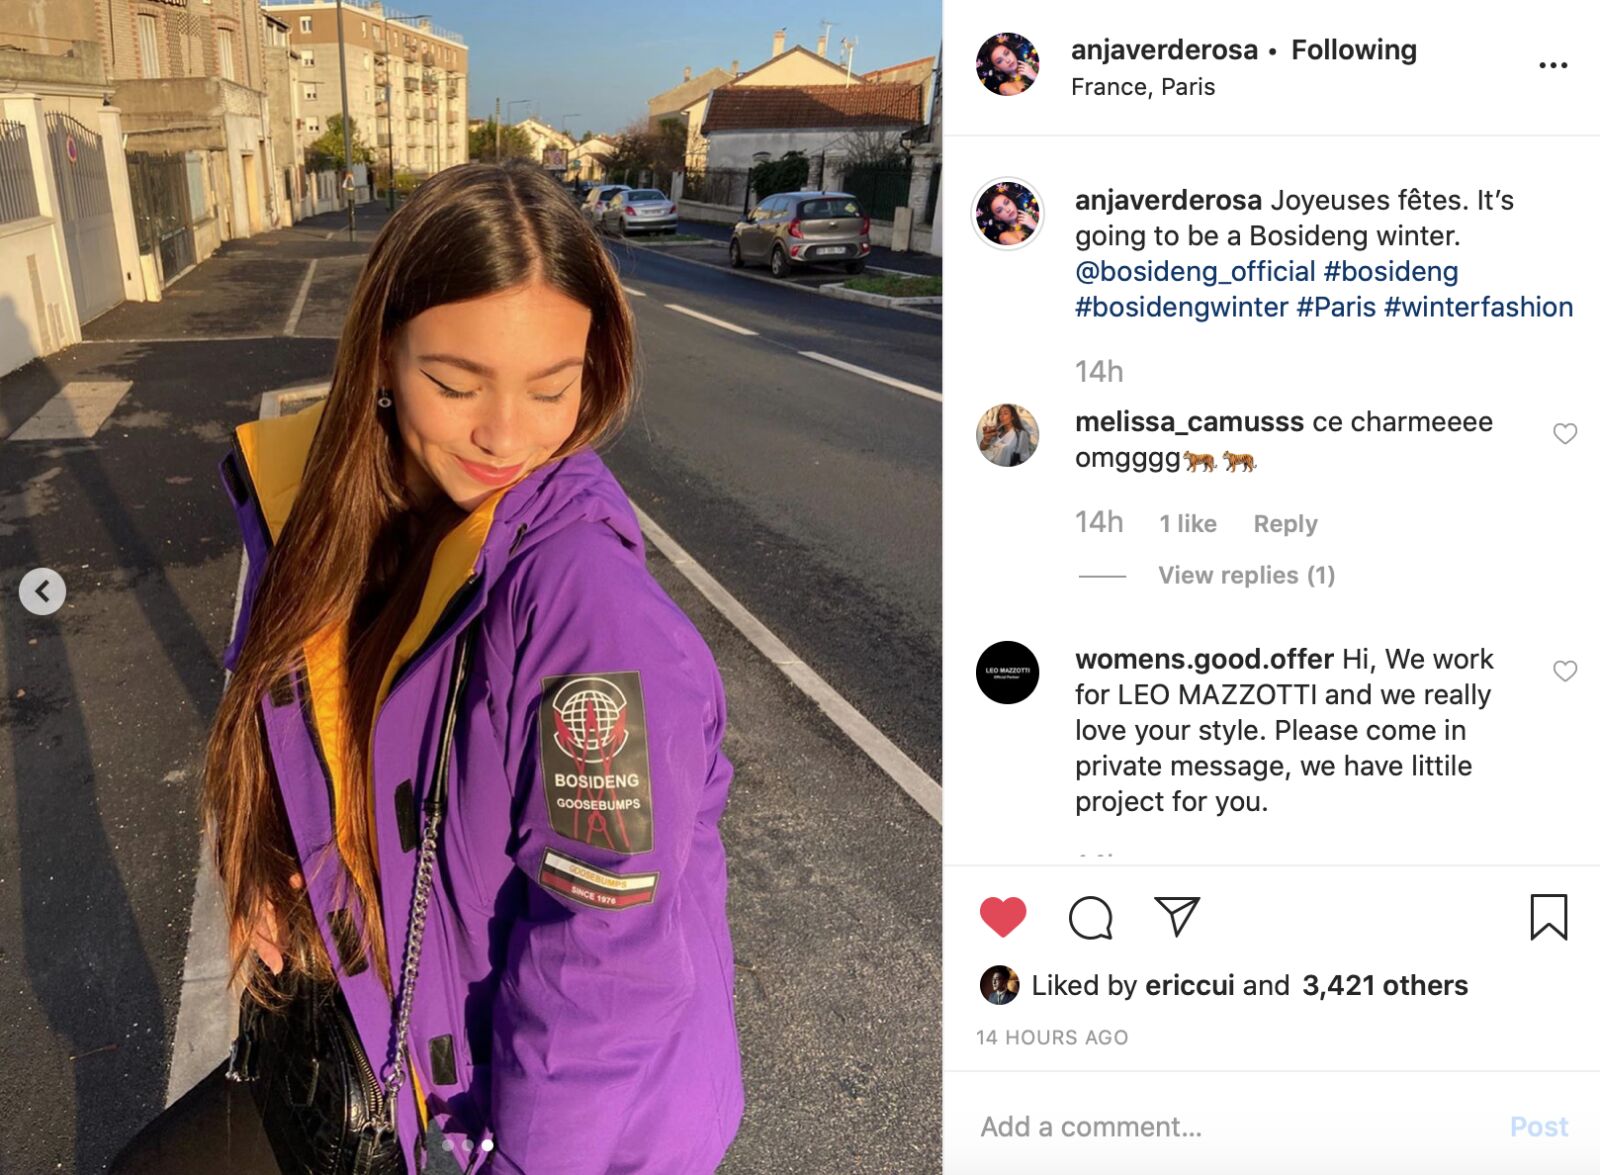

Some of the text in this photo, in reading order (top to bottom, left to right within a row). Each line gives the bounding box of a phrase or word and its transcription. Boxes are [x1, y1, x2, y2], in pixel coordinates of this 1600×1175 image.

[554, 773, 640, 790] BOSIDENG
[556, 797, 641, 811] GOOSEBUMPS
[569, 864, 628, 889] GOOSEBUMPS
[571, 886, 596, 901] SINCE
